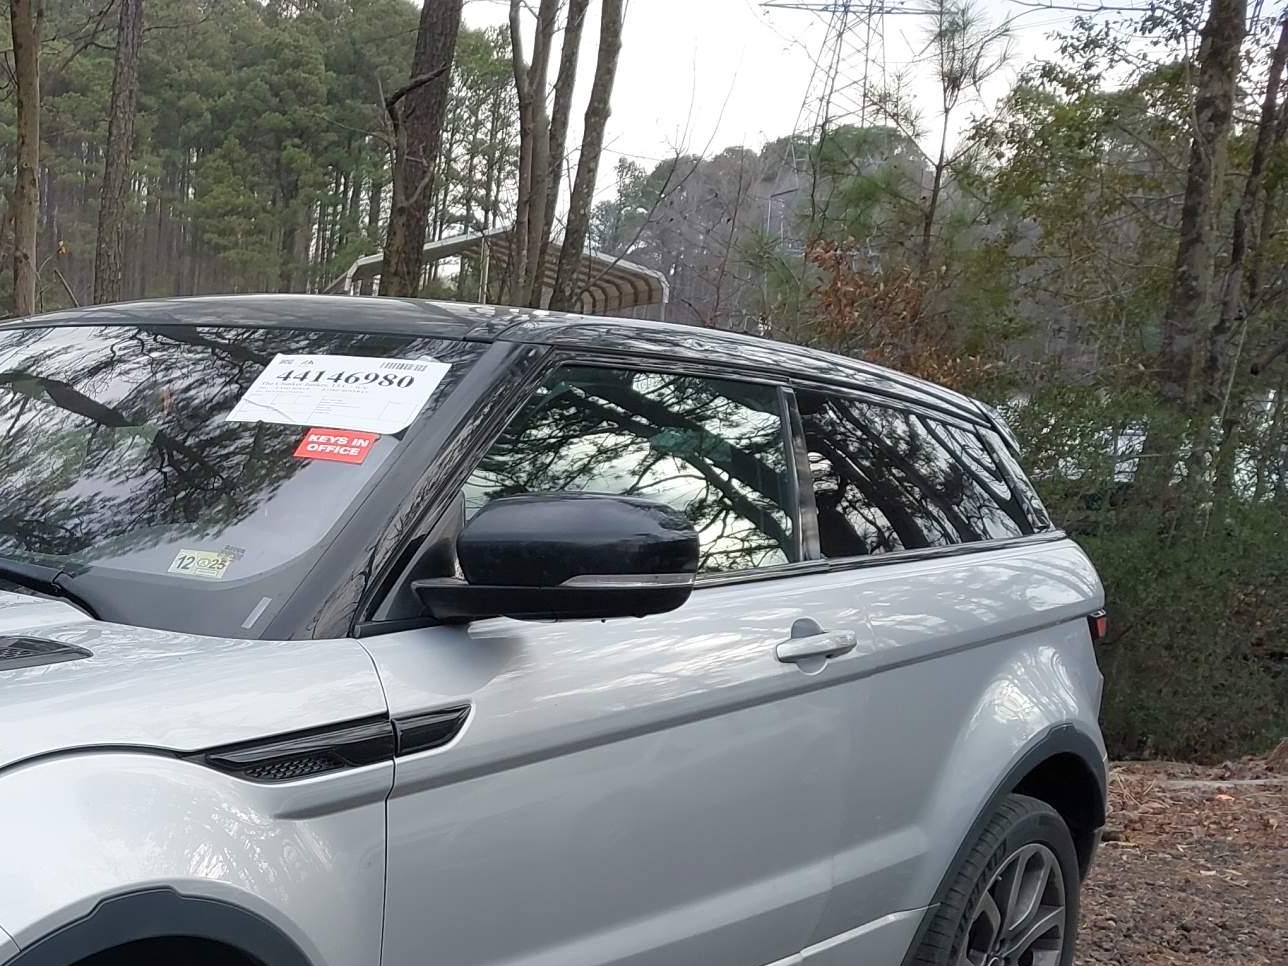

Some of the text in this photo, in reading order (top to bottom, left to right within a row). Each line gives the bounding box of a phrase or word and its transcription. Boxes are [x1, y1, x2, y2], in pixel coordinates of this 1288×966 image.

[276, 369, 415, 389] 44146980
[308, 434, 369, 447] KEYS IN
[307, 443, 361, 456] OFFICE
[176, 554, 226, 570] 12 25
